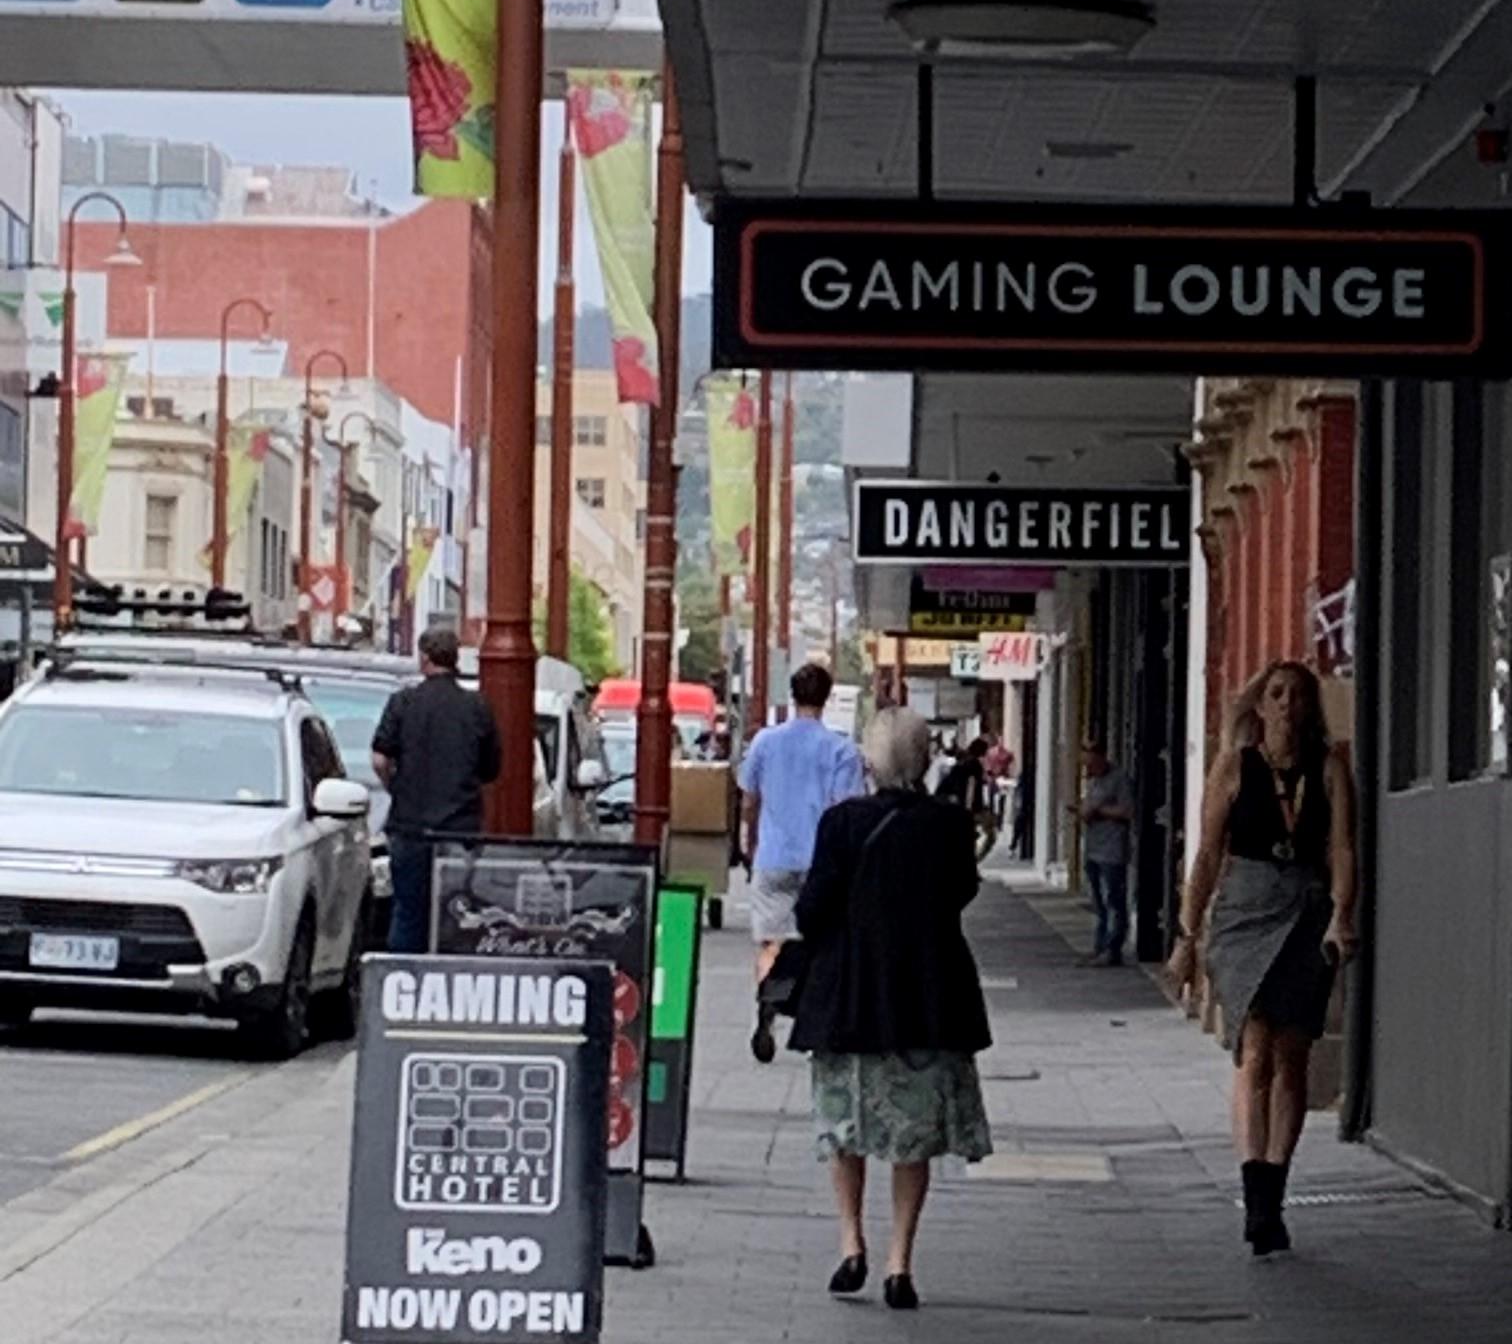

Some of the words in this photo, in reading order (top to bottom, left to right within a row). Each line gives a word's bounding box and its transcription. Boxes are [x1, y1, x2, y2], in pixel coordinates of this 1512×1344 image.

[800, 258, 1098, 313] GAMING
[1132, 263, 1426, 319] LOUNGE
[885, 498, 1180, 548] DANGERFIEL
[382, 971, 586, 1026] GAMING
[408, 1153, 548, 1176] CENTRAL
[408, 1174, 546, 1203] HOTEL
[357, 1286, 461, 1330] NOW
[467, 1290, 584, 1332] OPEN
